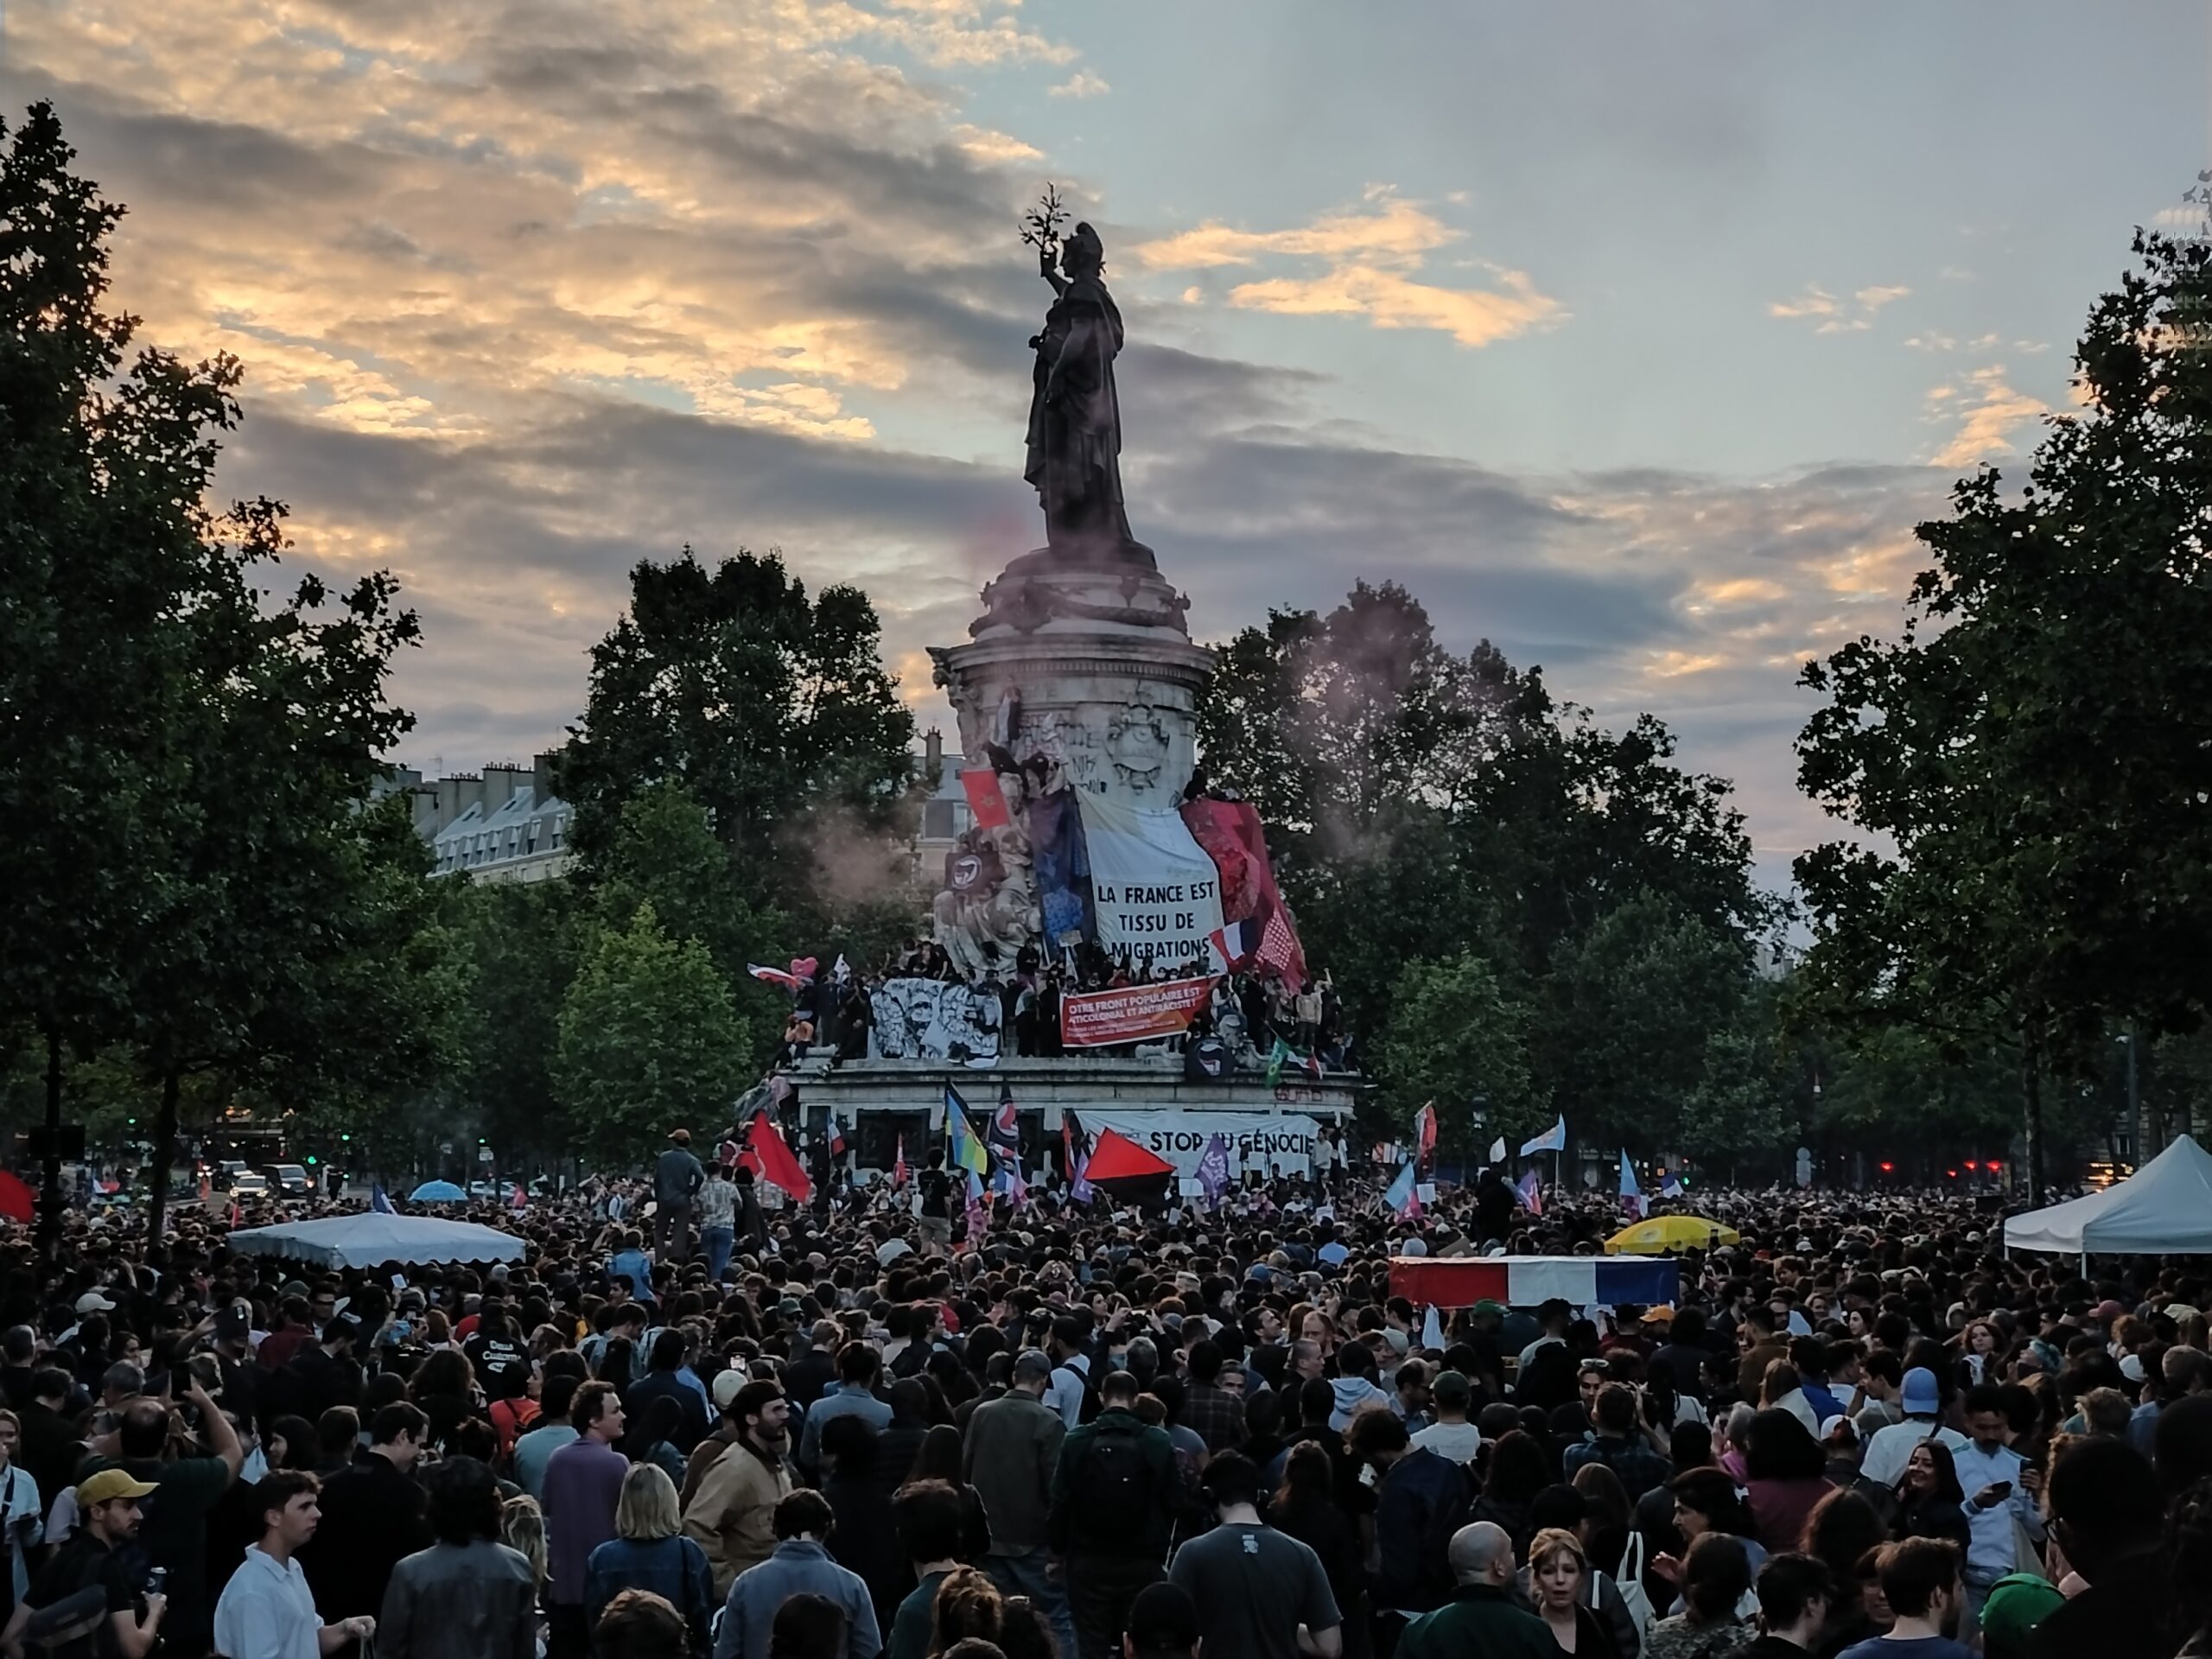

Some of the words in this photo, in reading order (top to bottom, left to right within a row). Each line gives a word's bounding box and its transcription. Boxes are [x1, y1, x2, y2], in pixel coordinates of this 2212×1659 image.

[1098, 886, 1116, 903] LA
[1125, 886, 1183, 904] FRANCE
[1191, 881, 1214, 900] EST
[1119, 914, 1166, 932] TISSU
[1175, 912, 1194, 929] DE
[1111, 938, 1210, 959] MIGRATIONS
[1096, 998, 1128, 1012] FRONT
[1129, 989, 1183, 1006] POPULAIRE
[1184, 987, 1200, 997] EST
[1127, 1007, 1136, 1017] ET
[1138, 999, 1191, 1015] ANTIRACISTE
[1150, 1132, 1204, 1152] STOP
